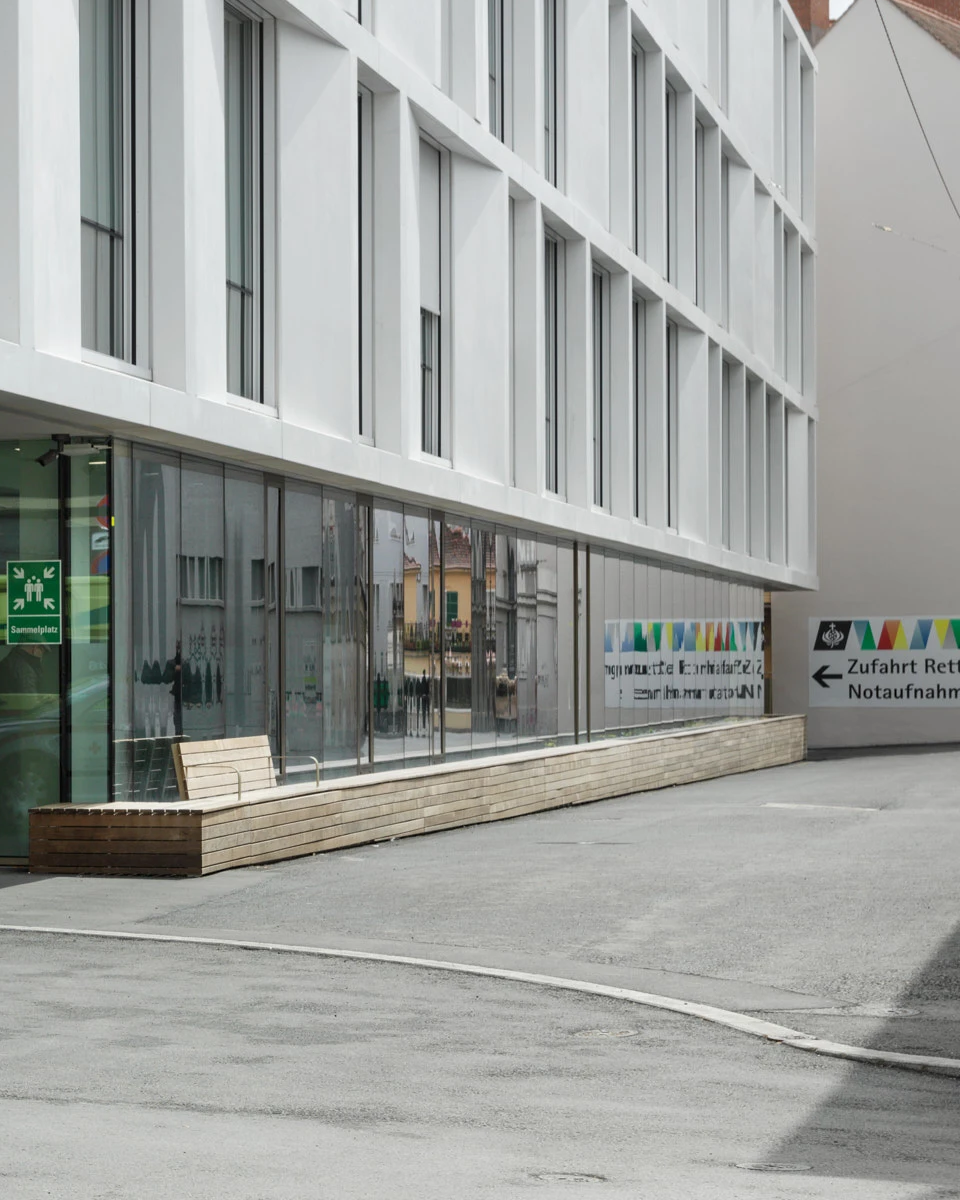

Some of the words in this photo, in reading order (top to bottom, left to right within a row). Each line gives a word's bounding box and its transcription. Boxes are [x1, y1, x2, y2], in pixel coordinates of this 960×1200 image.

[10, 625, 58, 635] Sammelplatz
[847, 658, 917, 674] Zufahrt
[848, 683, 960, 700] Notaufnahm
